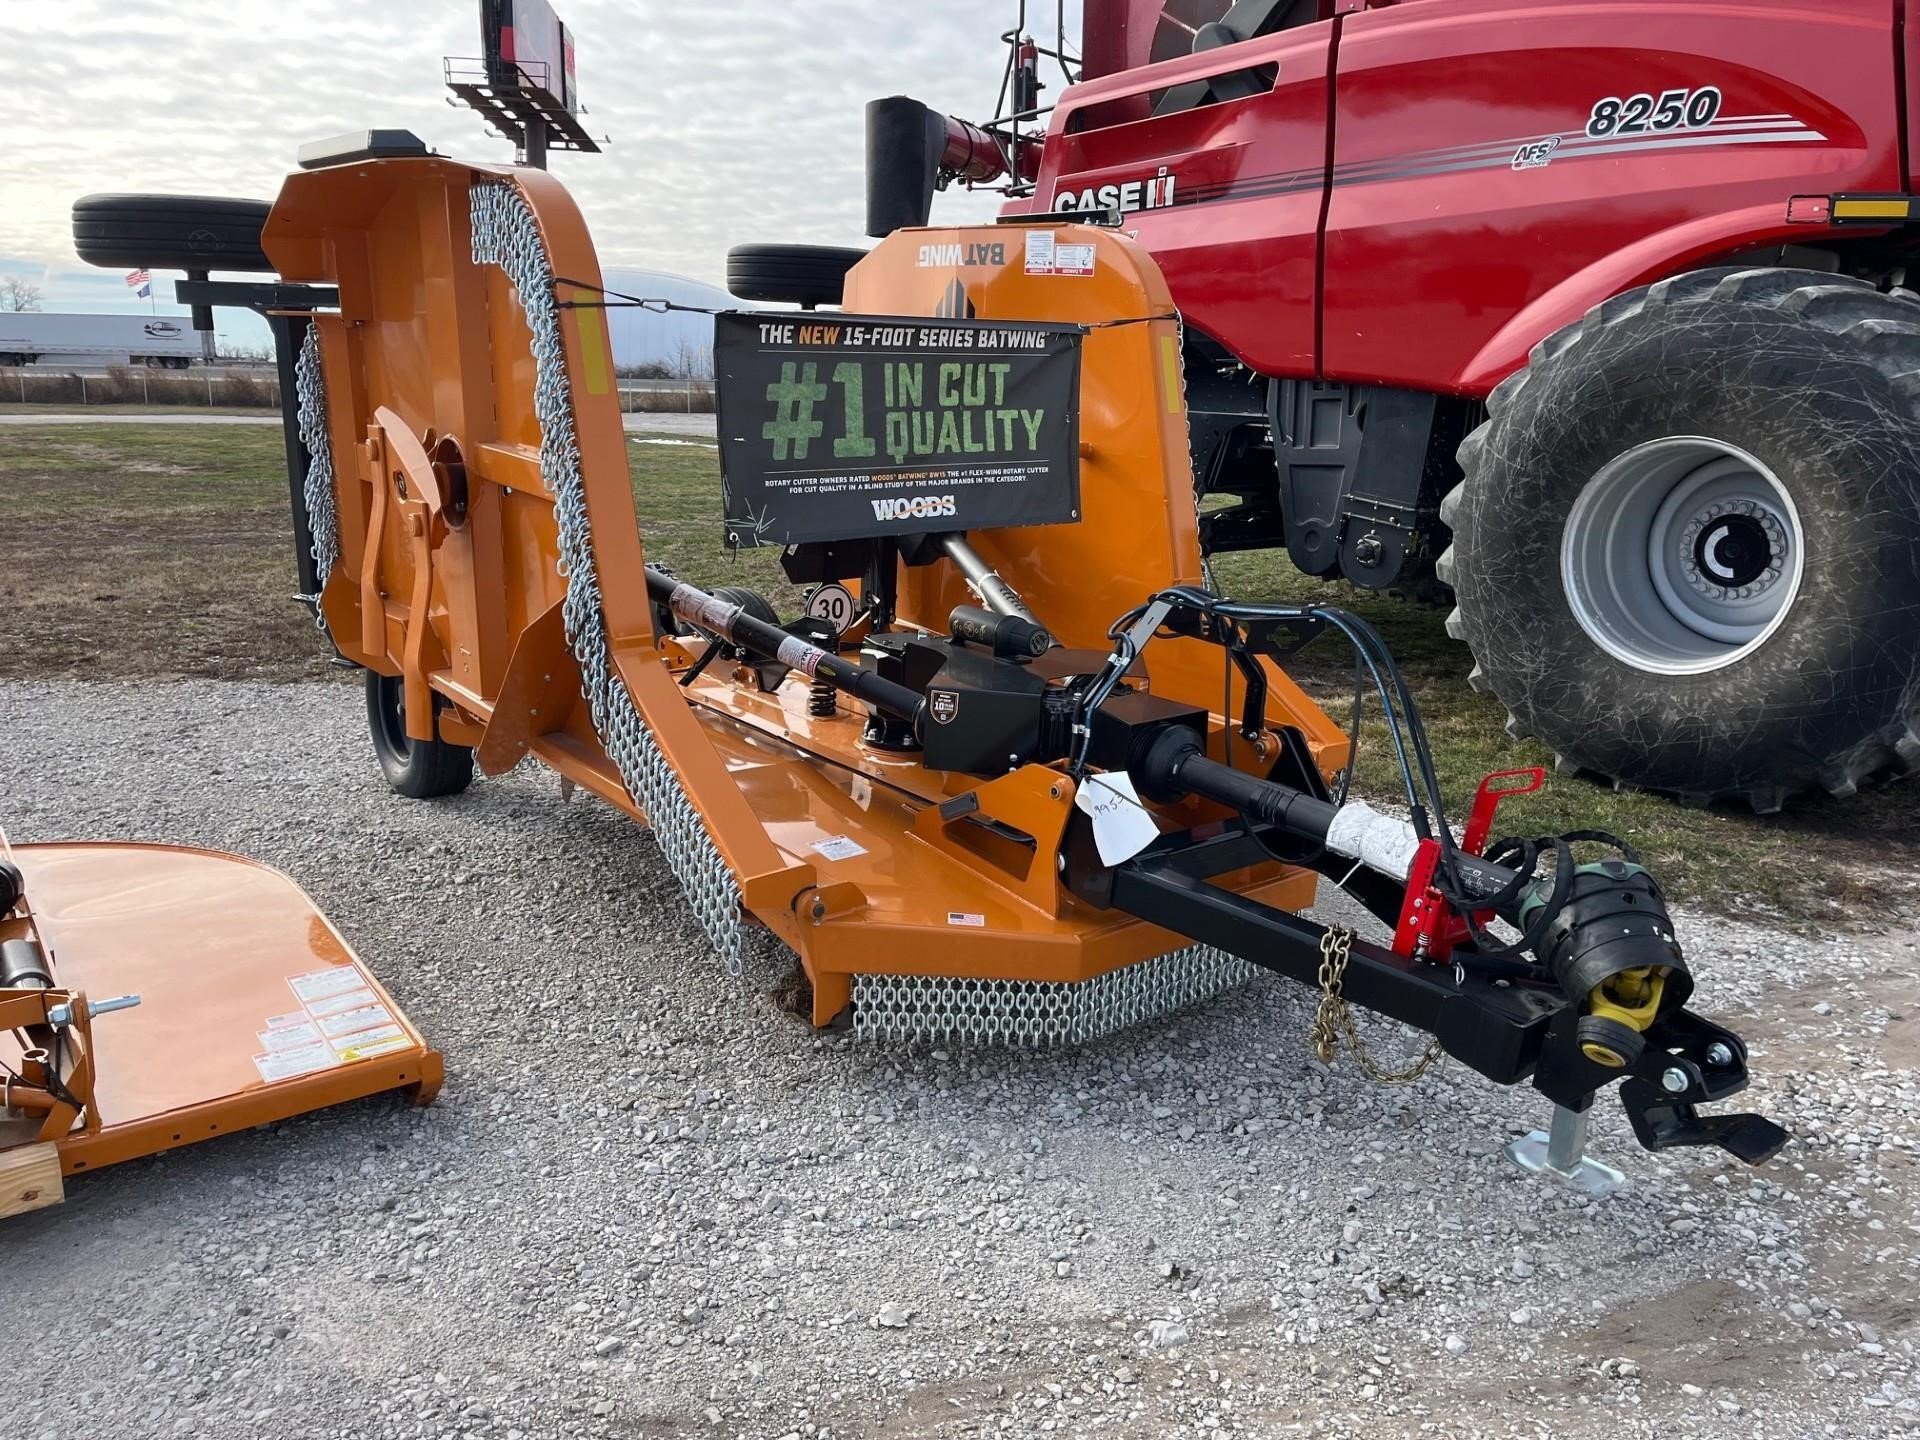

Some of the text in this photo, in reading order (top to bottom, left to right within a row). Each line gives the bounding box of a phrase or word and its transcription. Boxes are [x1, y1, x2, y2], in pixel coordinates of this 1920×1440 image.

[1585, 86, 1722, 139] 8250
[1513, 143, 1551, 162] AFS
[1054, 181, 1142, 212] CASE
[759, 324, 1047, 348] THE NEW 15-FOOT SERIES BATWING
[884, 362, 1011, 407] IN CUT
[762, 361, 876, 461] #1
[886, 408, 1045, 464] QUALITY
[765, 479, 791, 487] ROTARY
[793, 478, 818, 486] CUTTER
[820, 476, 847, 484] OWNERS
[849, 475, 870, 483] RATED
[947, 470, 960, 478] THE
[969, 468, 1001, 476] FLEX-WING
[1003, 467, 1025, 475] ROTARY
[1027, 466, 1049, 474] CUTTER
[819, 485, 847, 493] QUALITY
[864, 482, 883, 490] BLIND
[884, 481, 904, 489] STUDY
[915, 479, 927, 487] THE
[928, 478, 949, 486] MAJOR
[950, 477, 974, 485] BRANDS
[871, 495, 956, 521] WOODS
[818, 597, 844, 619] 30
